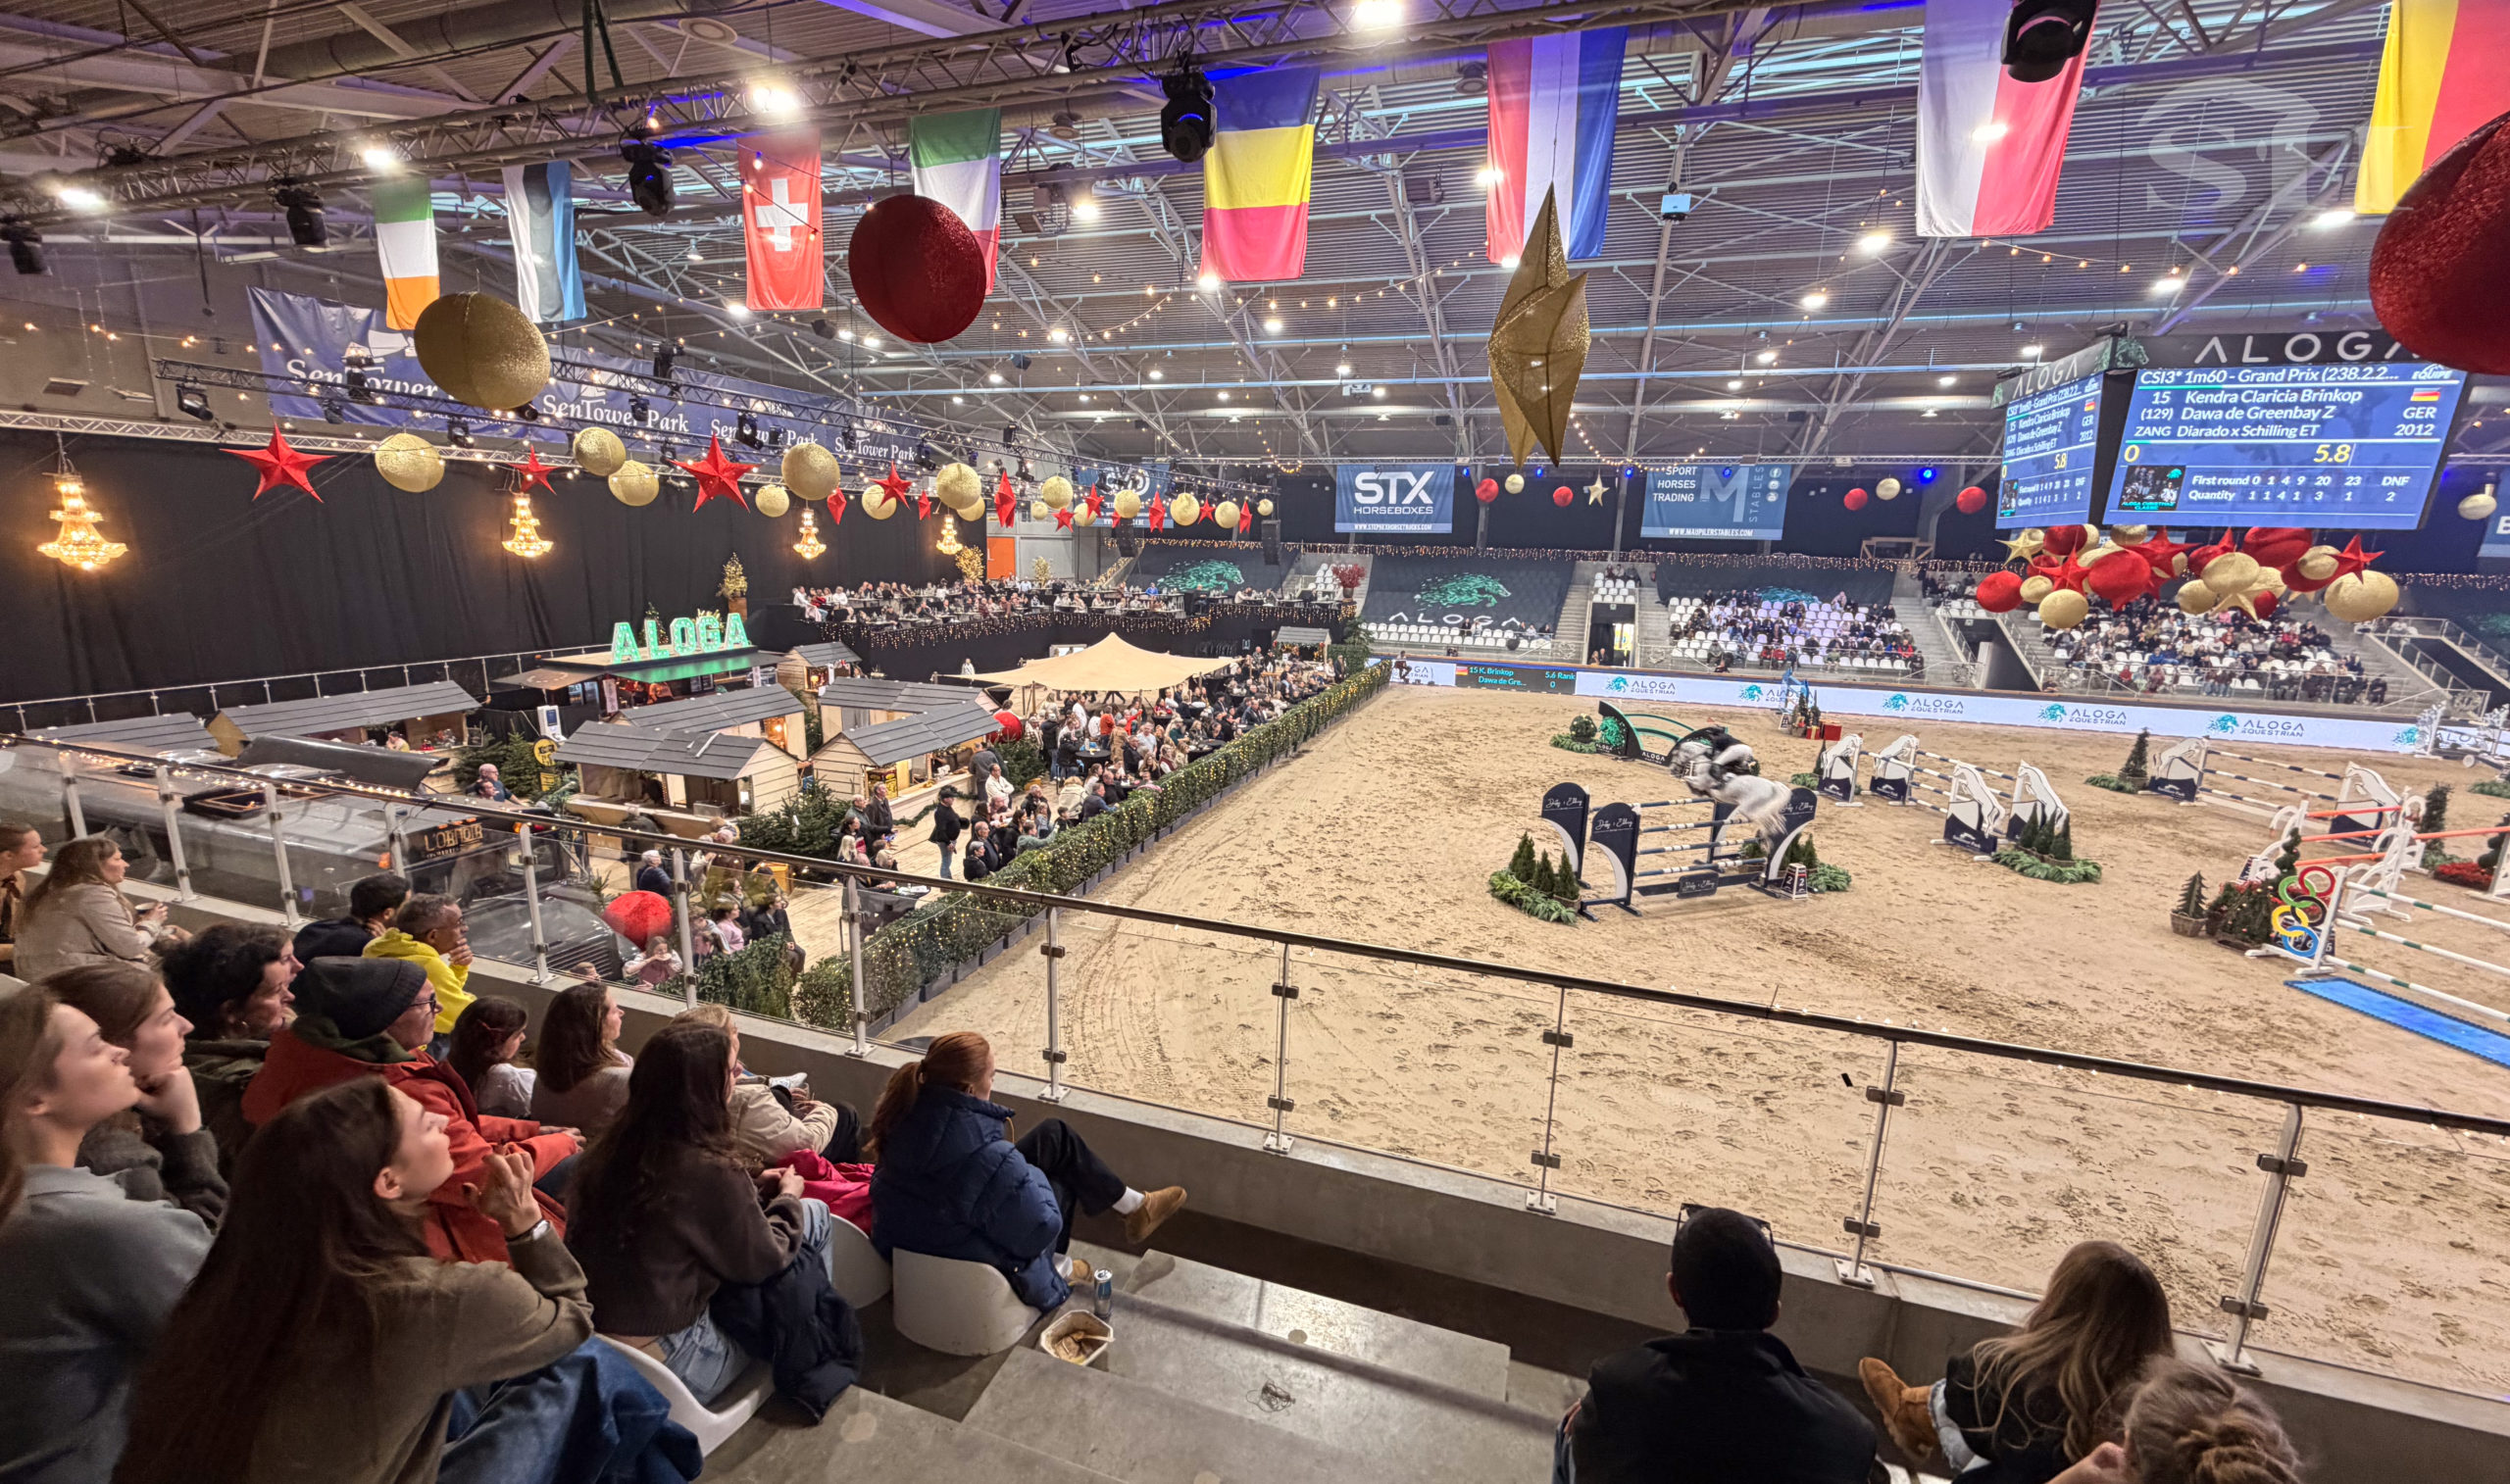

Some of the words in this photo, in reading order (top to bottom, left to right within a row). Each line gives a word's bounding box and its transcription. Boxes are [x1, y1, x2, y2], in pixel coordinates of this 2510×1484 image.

[2013, 356, 2077, 399] ALOGA
[2184, 370, 2228, 383] 1m60
[2238, 369, 2284, 382] Grand
[2287, 368, 2319, 381] Prix
[2152, 392, 2171, 404] 15
[2185, 391, 2239, 404] Kendra
[2240, 390, 2297, 403] Claricia
[2300, 389, 2363, 404] Brinkop
[2140, 408, 2174, 420] (129)
[2182, 408, 2225, 420] Dawa
[2225, 407, 2244, 420] de
[2246, 406, 2321, 420] Greenbay
[2322, 406, 2336, 419] Z
[2403, 407, 2437, 419] GER
[647, 410, 689, 432] Park
[2134, 426, 2171, 437] ZANG
[2177, 425, 2230, 437] Diarado
[2231, 428, 2239, 437] x
[2241, 424, 2299, 438] Schilling
[2299, 424, 2320, 436] ET
[2394, 423, 2435, 436] 2012
[890, 444, 918, 462] Park
[2124, 444, 2140, 463] 0
[2313, 444, 2351, 463] 5.8
[1666, 467, 1697, 475] SPORT
[1657, 480, 1696, 489] HORSES
[2191, 475, 2217, 485] First
[2218, 475, 2249, 485] round
[2252, 475, 2261, 485] 0
[2267, 475, 2276, 485] 1
[2282, 475, 2290, 485] 4
[2297, 476, 2306, 485] 9
[2315, 475, 2332, 485] 20
[2344, 475, 2362, 486] 23
[2382, 476, 2410, 486] DNF
[1355, 470, 1434, 505] STX
[1653, 493, 1694, 502] TRADING
[1749, 467, 1765, 522] STABLES
[2188, 490, 2235, 502] Quantity
[2249, 491, 2256, 500] 1
[2264, 491, 2271, 500] 1
[2278, 491, 2285, 500] 4
[2292, 491, 2300, 501] 1
[2314, 491, 2324, 501] 3
[2344, 491, 2352, 501] 1
[2385, 491, 2396, 502] 2
[1353, 506, 1433, 515] HORSEBOXES
[1389, 612, 1521, 626] ALOGA
[611, 613, 749, 664] ALOGA
[1487, 668, 1514, 677] Brinkop
[1632, 680, 1676, 690] ALOGA
[1912, 699, 1964, 709] ALOGA
[2071, 709, 2127, 719] ALOGA
[2069, 717, 2126, 725] EQUESTRIAN
[2243, 719, 2304, 731] ALOGA
[2241, 728, 2303, 737] EQUESTRIAN
[1641, 752, 1665, 762] ALOGA
